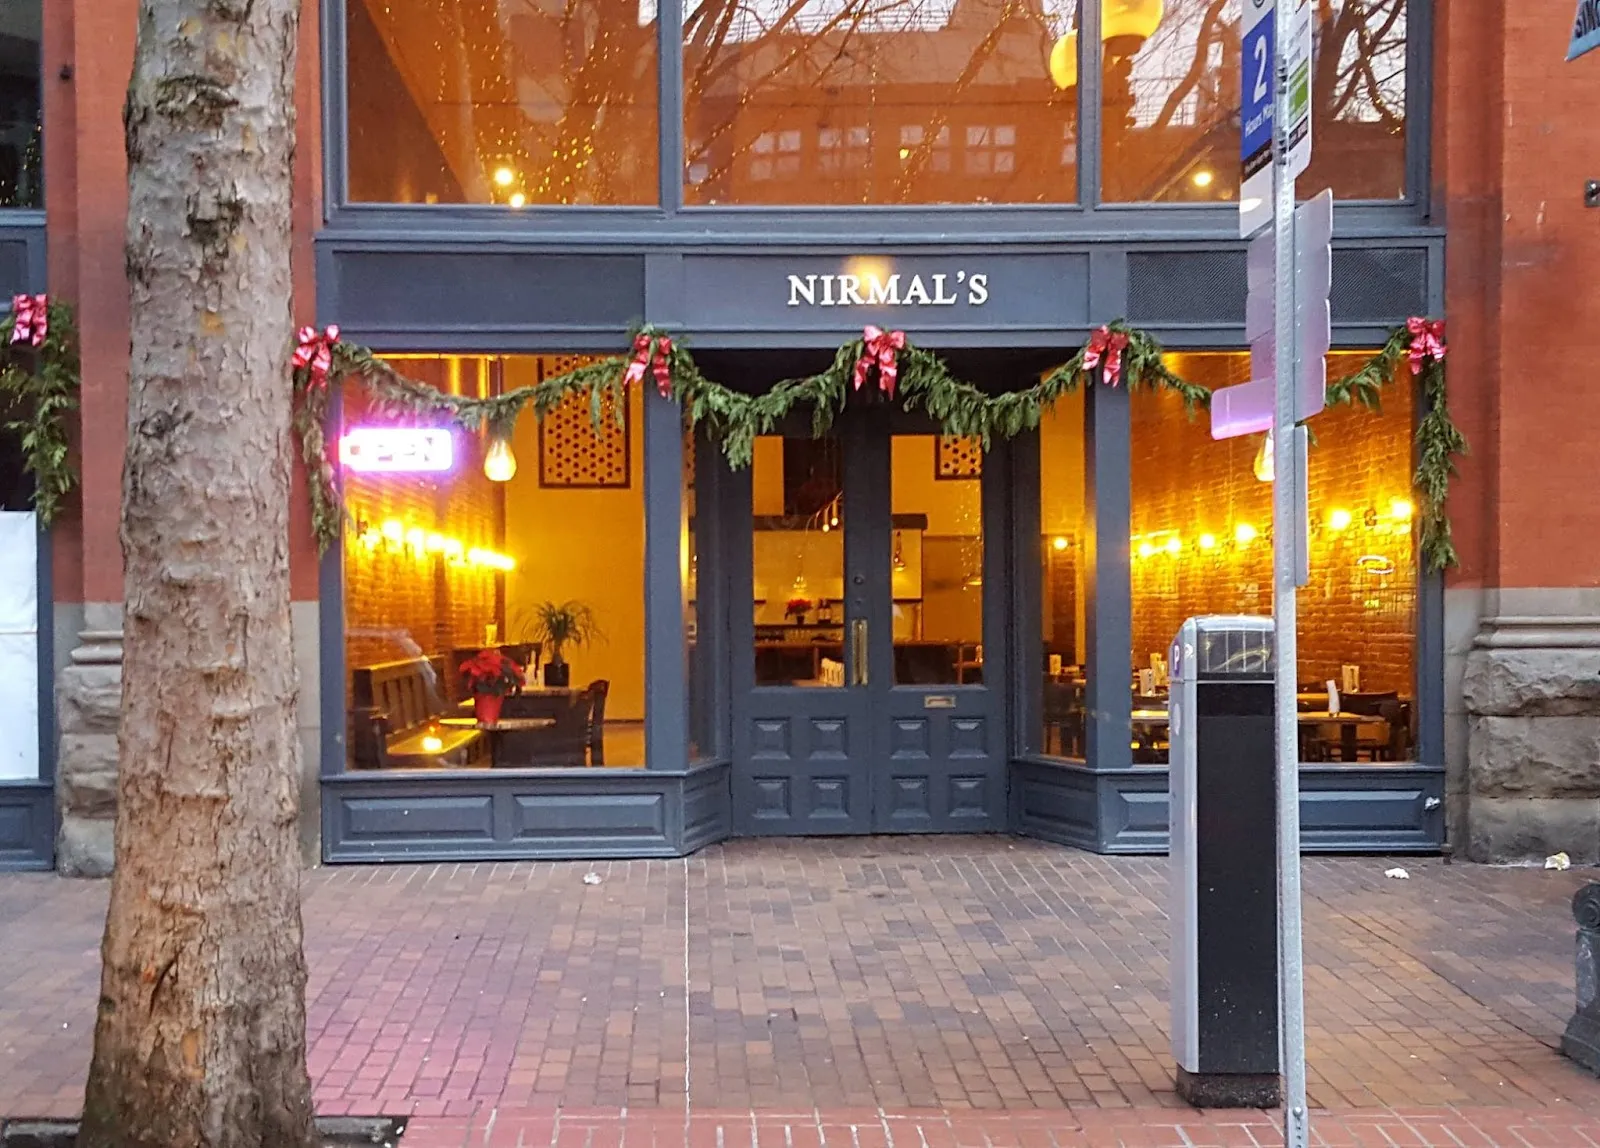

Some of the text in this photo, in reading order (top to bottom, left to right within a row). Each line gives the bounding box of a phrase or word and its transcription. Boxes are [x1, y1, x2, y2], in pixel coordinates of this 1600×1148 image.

[1253, 35, 1267, 104] 2
[1245, 113, 1263, 138] Hours
[787, 271, 989, 305] NIRMAL'S
[340, 433, 447, 468] OPEN
[1174, 645, 1180, 670] P
